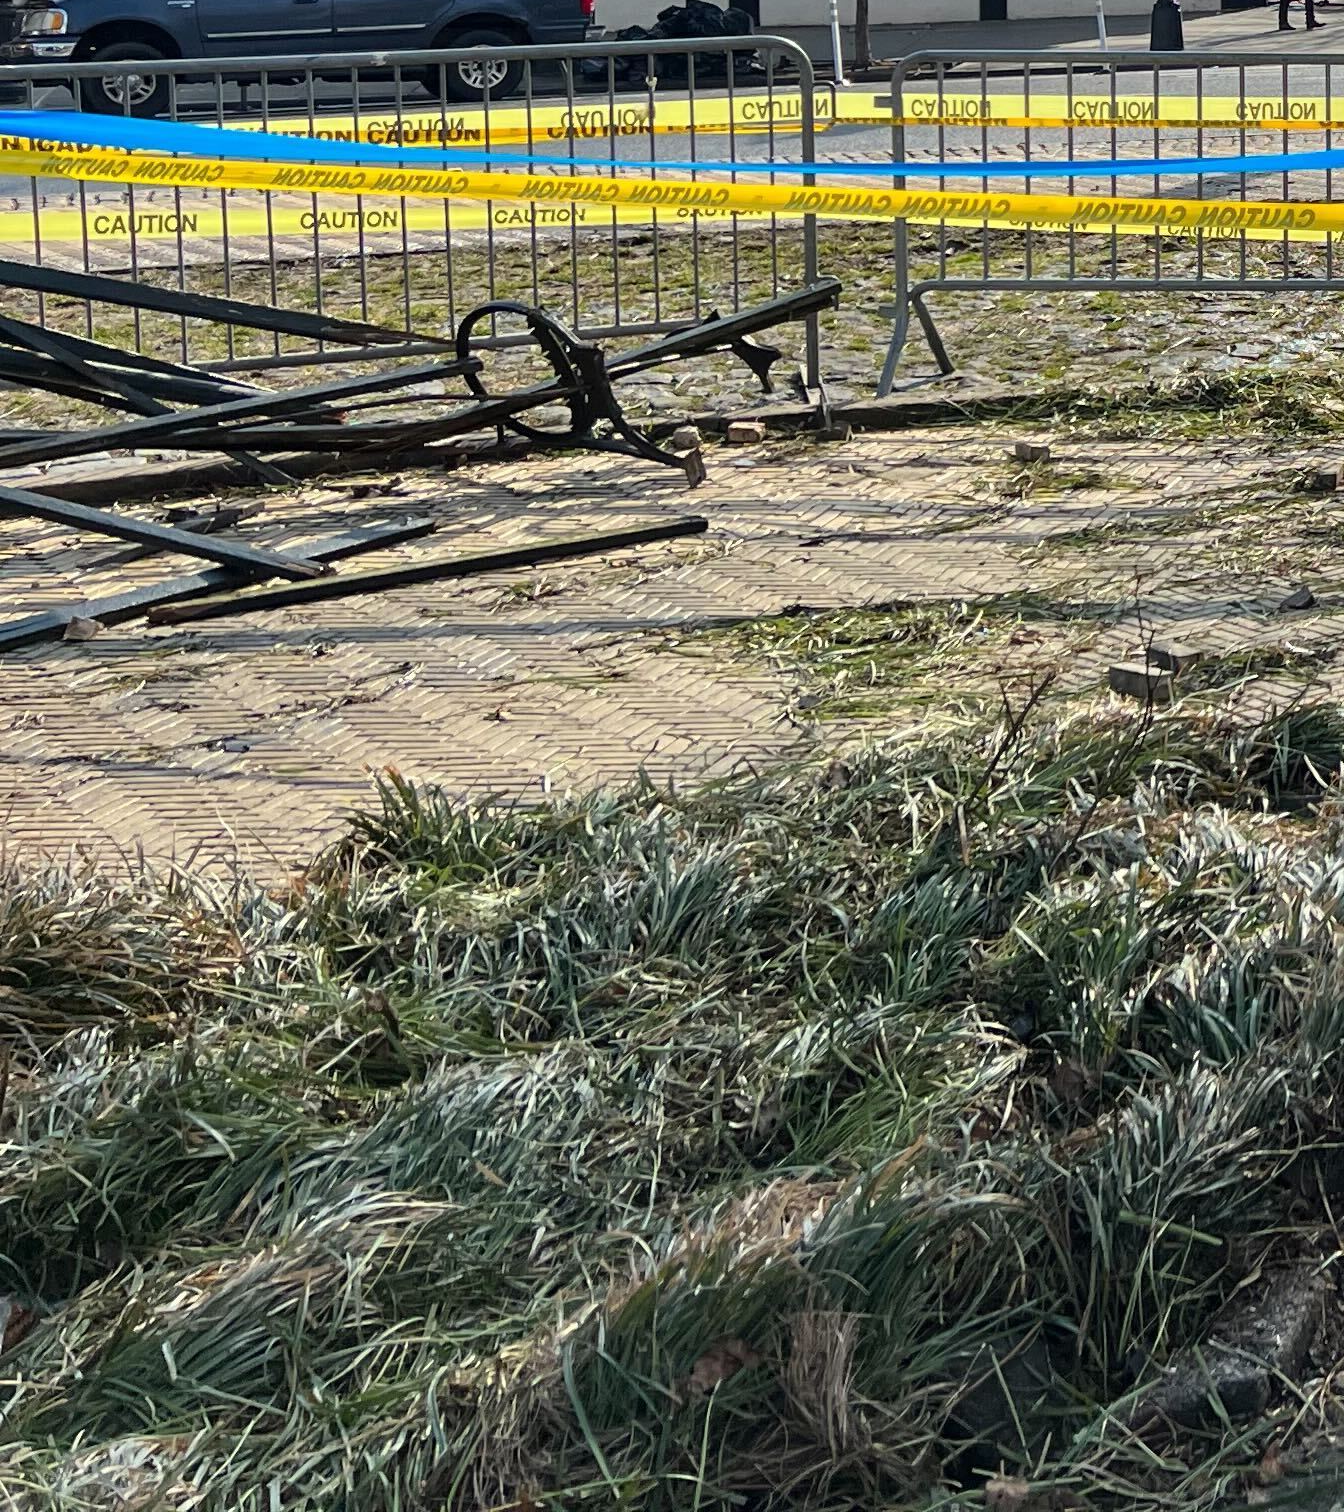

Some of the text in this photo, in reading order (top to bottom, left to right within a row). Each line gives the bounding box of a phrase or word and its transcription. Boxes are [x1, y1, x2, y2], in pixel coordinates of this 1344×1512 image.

[94, 213, 198, 235] CAUTION
[300, 210, 399, 231] CAUTION
[494, 208, 587, 226] CAUTION
